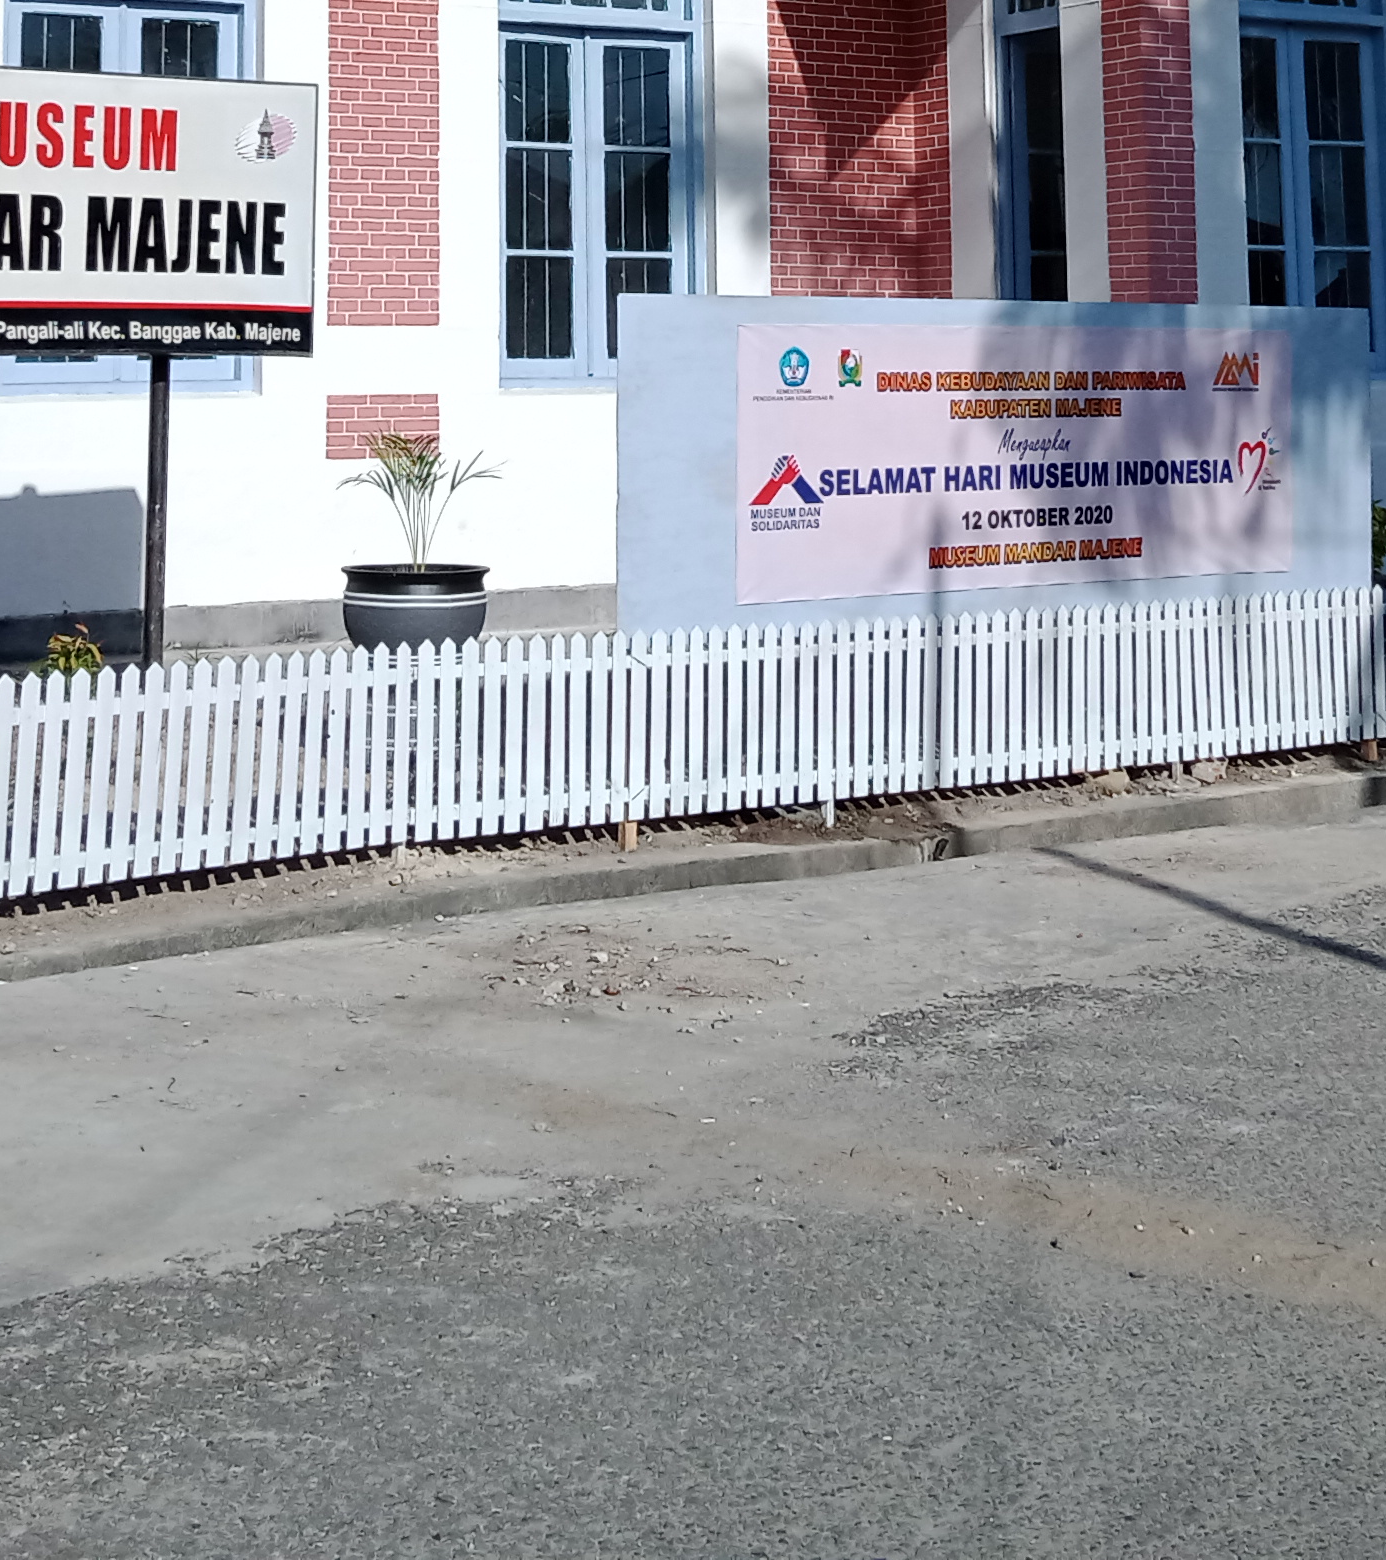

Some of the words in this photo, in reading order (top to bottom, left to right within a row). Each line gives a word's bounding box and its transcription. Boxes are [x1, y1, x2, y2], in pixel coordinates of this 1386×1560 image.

[85, 195, 286, 276] MAJENE
[88, 321, 126, 340] Kec.
[129, 321, 202, 344] Banggae
[205, 321, 241, 340] Kab.
[244, 322, 301, 345] Majene
[877, 371, 932, 392] DINAS
[936, 371, 1050, 392] KEBUDAYAAN
[1055, 371, 1088, 390] DAN
[1092, 370, 1186, 390] PARIWISATA
[950, 398, 1052, 419] KABUPATEN
[1056, 397, 1122, 418] MAJENE
[819, 466, 936, 497] SELAMAT
[944, 465, 1002, 492] HARI
[1009, 461, 1109, 490] MUSEUM
[1116, 458, 1234, 486] INDONESIA
[750, 507, 796, 520] MUSEUM
[799, 507, 821, 518] DAN
[751, 519, 820, 532] SOLIDARITAS
[962, 511, 982, 530] 12
[988, 507, 1070, 529] OKTOBER
[1074, 505, 1113, 525] 2020
[929, 545, 1001, 569] MUSEUM
[1004, 540, 1076, 565] MANDAR
[1079, 537, 1143, 560] MAJENE
